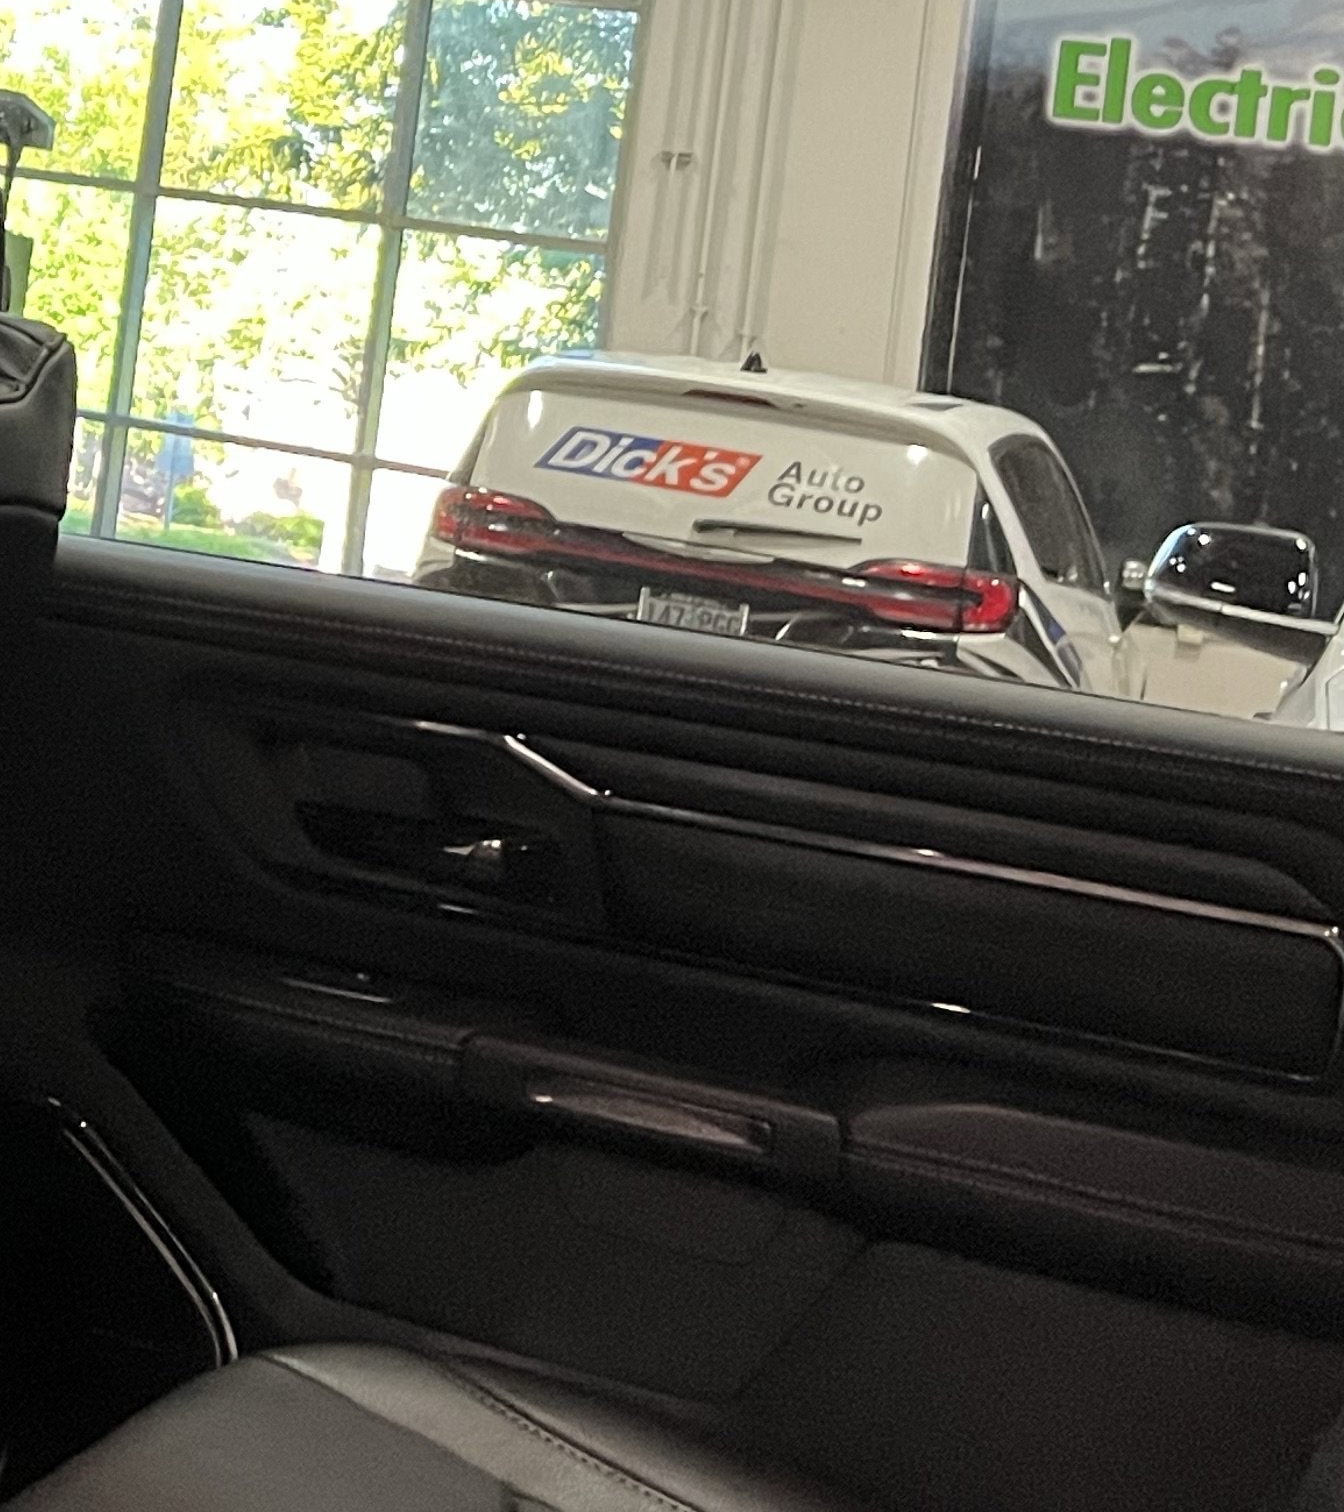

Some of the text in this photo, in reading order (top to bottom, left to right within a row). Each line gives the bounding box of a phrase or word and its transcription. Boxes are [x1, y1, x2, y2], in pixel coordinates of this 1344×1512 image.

[1052, 37, 1344, 147] Electri
[778, 461, 865, 493] Auto
[767, 482, 883, 526] Group
